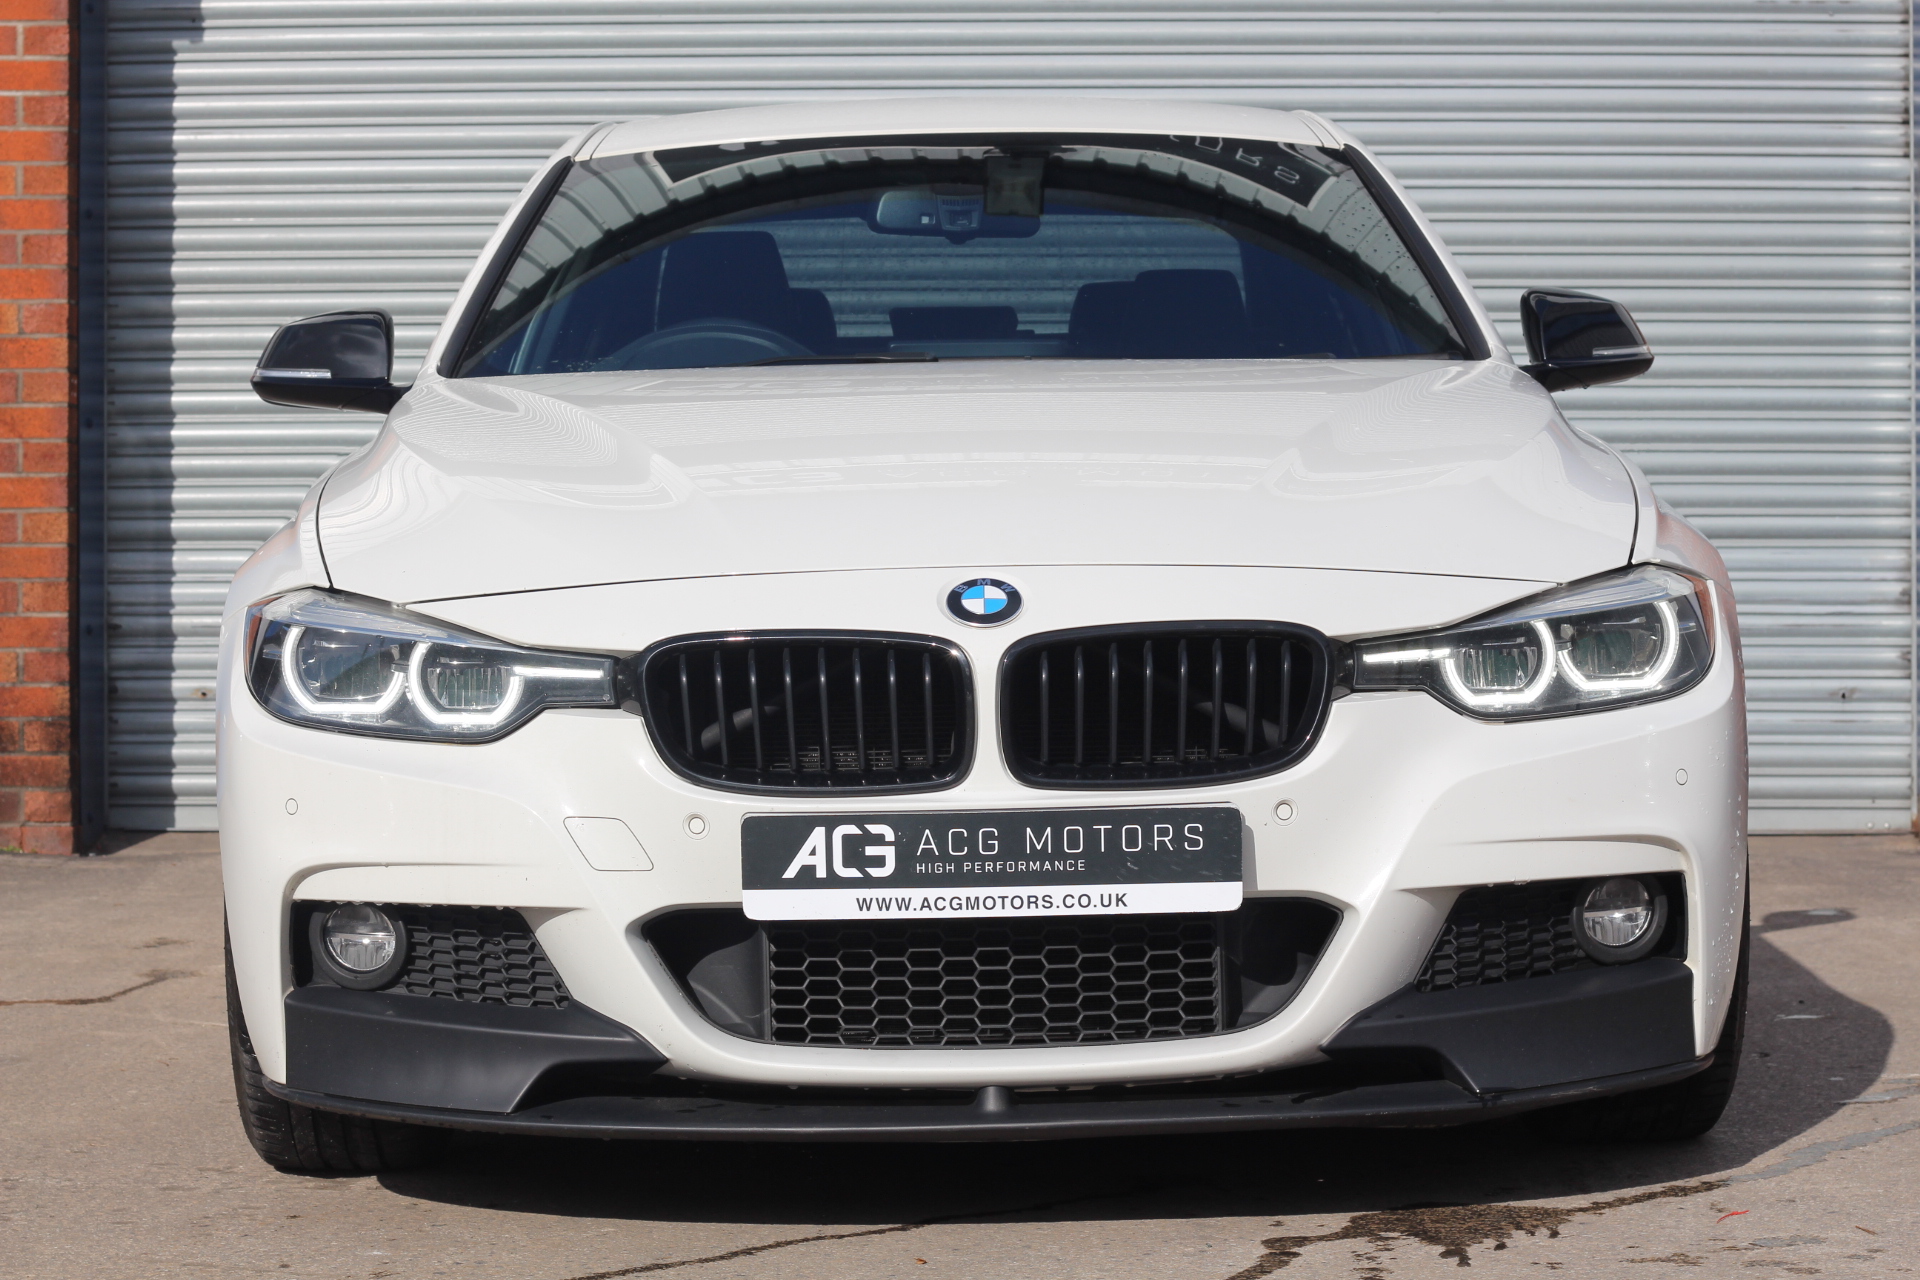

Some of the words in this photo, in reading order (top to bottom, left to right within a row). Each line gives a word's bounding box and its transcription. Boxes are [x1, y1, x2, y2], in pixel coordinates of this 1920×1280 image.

[953, 578, 1016, 593] BMW
[916, 827, 999, 857] ACG
[1026, 823, 1204, 854] MOTORS
[781, 823, 896, 879] ACG
[916, 862, 955, 874] HIGH
[963, 859, 1086, 873] PERFORMANCE
[856, 892, 1128, 912] WWW.ACGMOTORS.CO.UK
